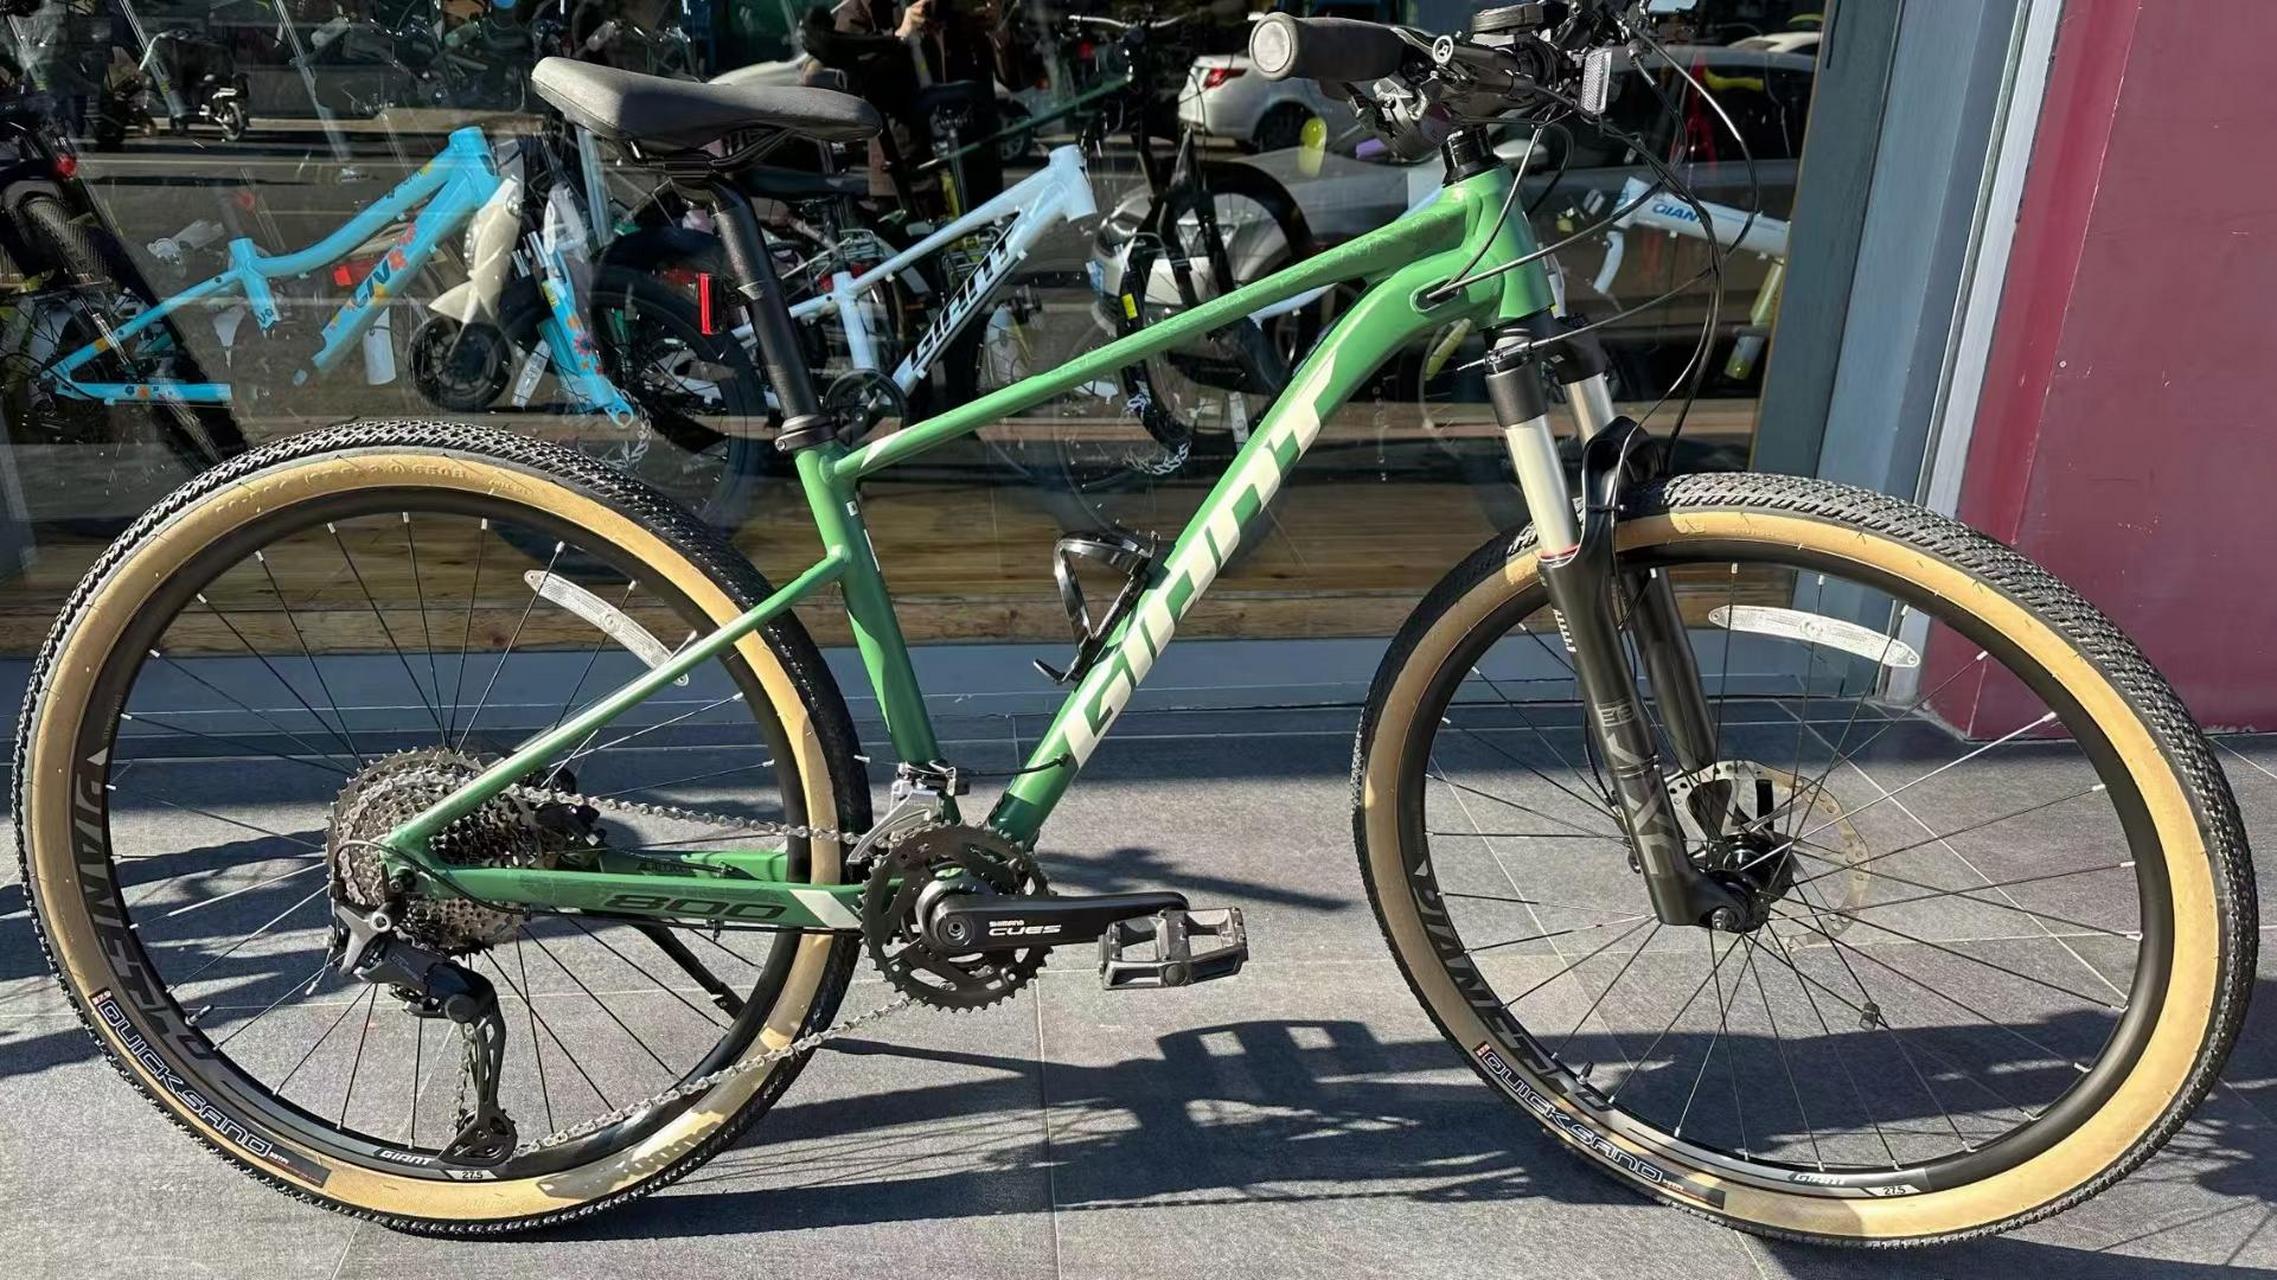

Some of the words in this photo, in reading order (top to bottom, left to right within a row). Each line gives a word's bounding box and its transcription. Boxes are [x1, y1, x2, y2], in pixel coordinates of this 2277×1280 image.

[1652, 203, 1699, 222] GIAN
[1062, 349, 1338, 769] GIANT
[602, 893, 787, 920] 800
[988, 924, 1062, 937] CUES
[98, 999, 274, 1159] QUICKSAND
[1481, 1050, 1664, 1184] QUICKSAND
[379, 1149, 436, 1166] GIANT
[461, 1171, 484, 1180] 27.5
